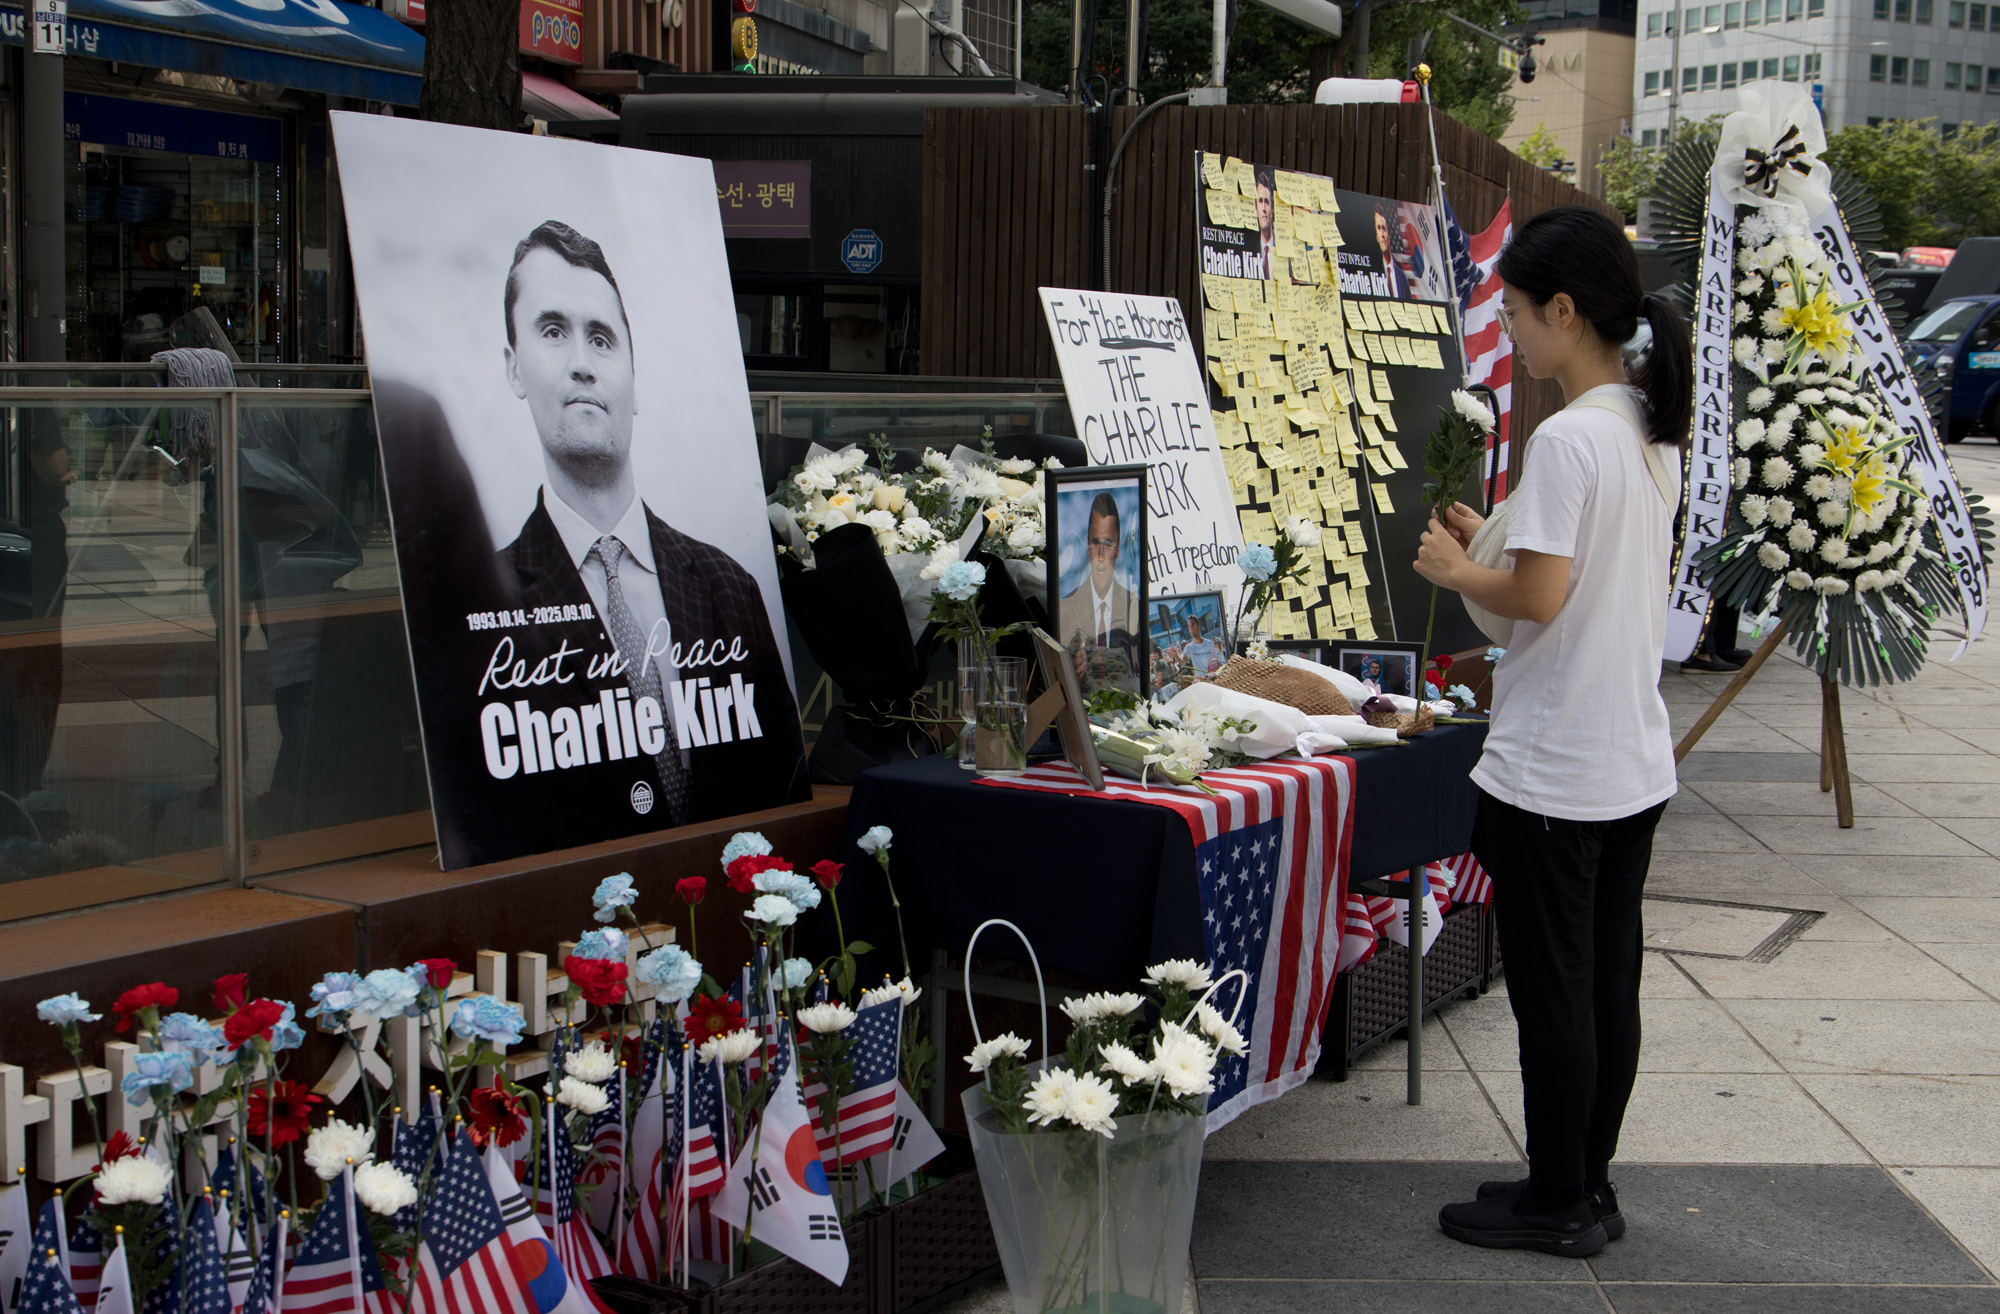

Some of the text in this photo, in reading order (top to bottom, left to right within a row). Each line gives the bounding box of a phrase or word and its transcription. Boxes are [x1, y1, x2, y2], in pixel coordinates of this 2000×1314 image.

[37, 12, 65, 24] 남대문로
[49, 1, 57, 12] 9
[41, 23, 62, 45] 11
[532, 10, 580, 50] proto
[848, 243, 876, 259] ADT
[1203, 227, 1245, 245] REST IN PEACE
[1203, 245, 1265, 280] Charlie Kirk
[1348, 253, 1354, 265] IN
[1354, 254, 1371, 267] PEACE
[1338, 267, 1391, 297] Charlie Kirk
[1051, 301, 1091, 346] For
[1088, 298, 1131, 341] the
[1098, 355, 1151, 403] THE
[1673, 213, 1733, 615] WE ARE CHARLIE KRK
[1085, 402, 1210, 466] CHARLIE
[1147, 460, 1200, 518] IRK
[1171, 521, 1239, 573] freedom
[466, 603, 595, 631] 1993.10.14.~2025.09.10.
[478, 617, 749, 696] Rest in Peace
[480, 672, 763, 780] Charlie Kirk
